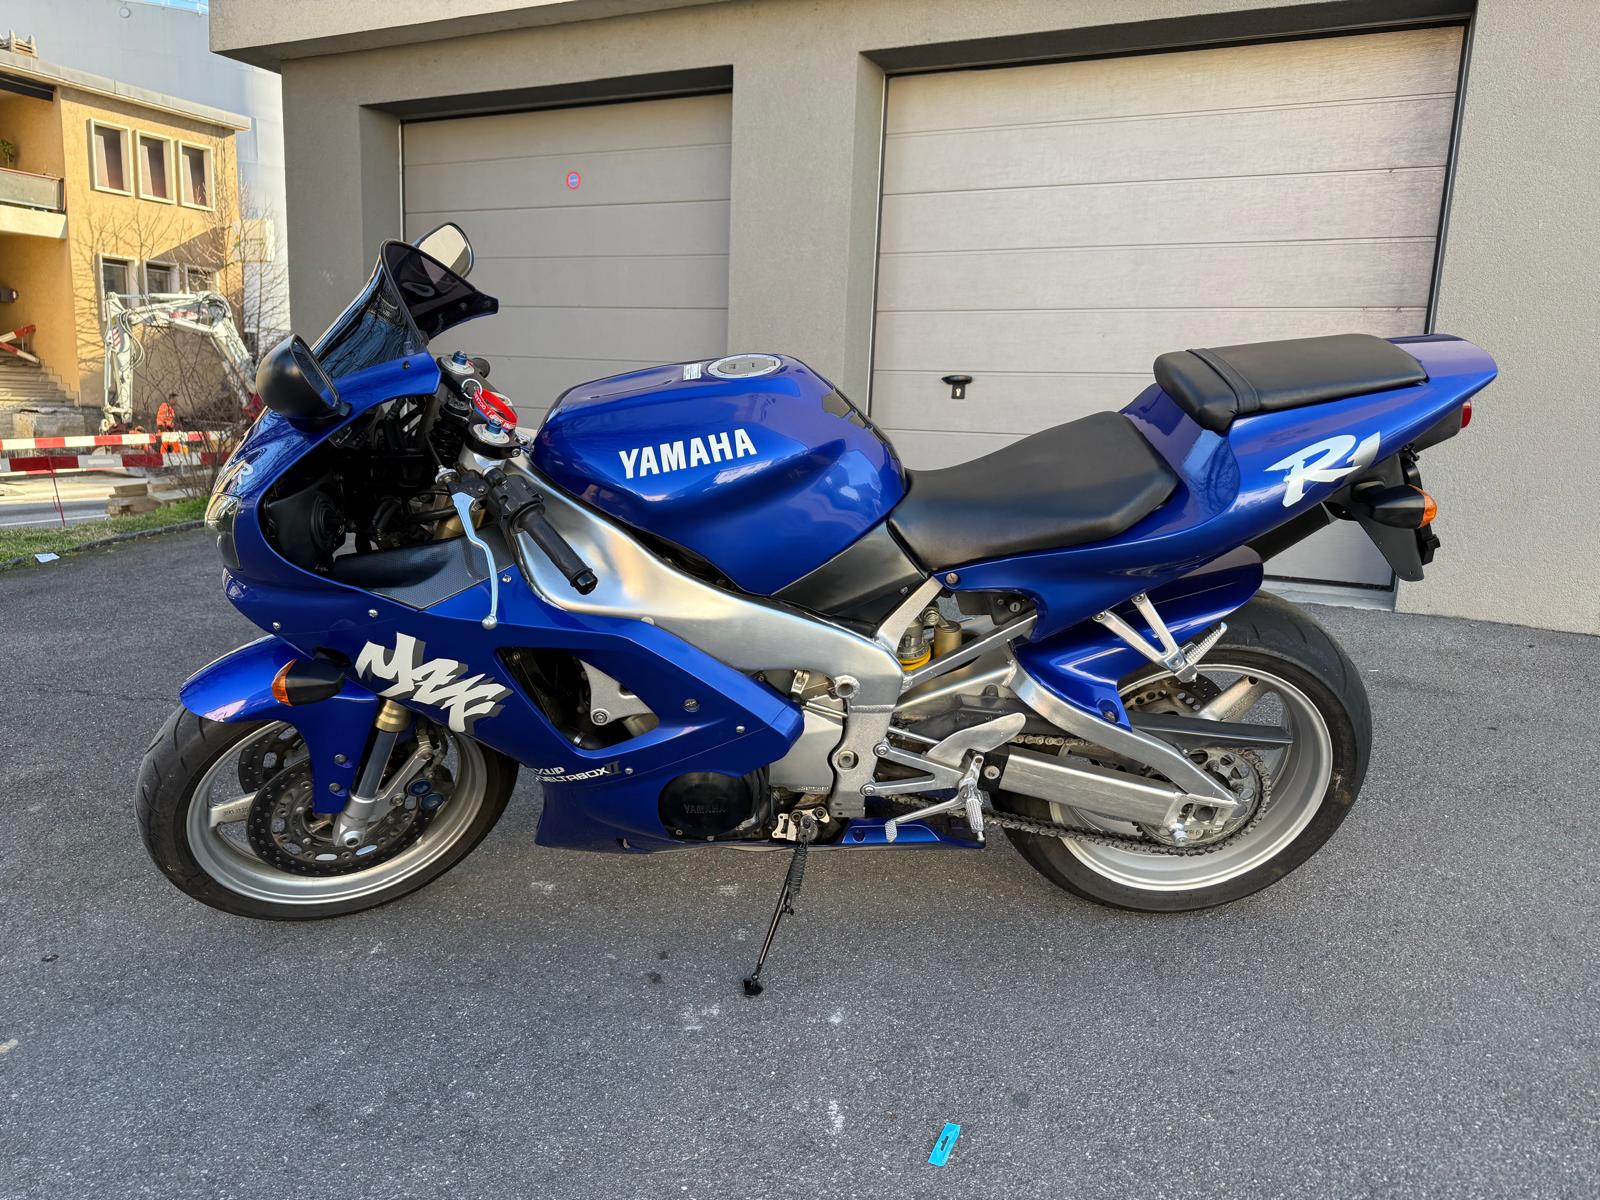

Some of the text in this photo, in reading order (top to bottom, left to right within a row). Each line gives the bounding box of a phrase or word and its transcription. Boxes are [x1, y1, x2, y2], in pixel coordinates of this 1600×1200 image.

[618, 428, 758, 480] YAMAHA
[1263, 431, 1381, 508] R1
[354, 632, 513, 734] YZF
